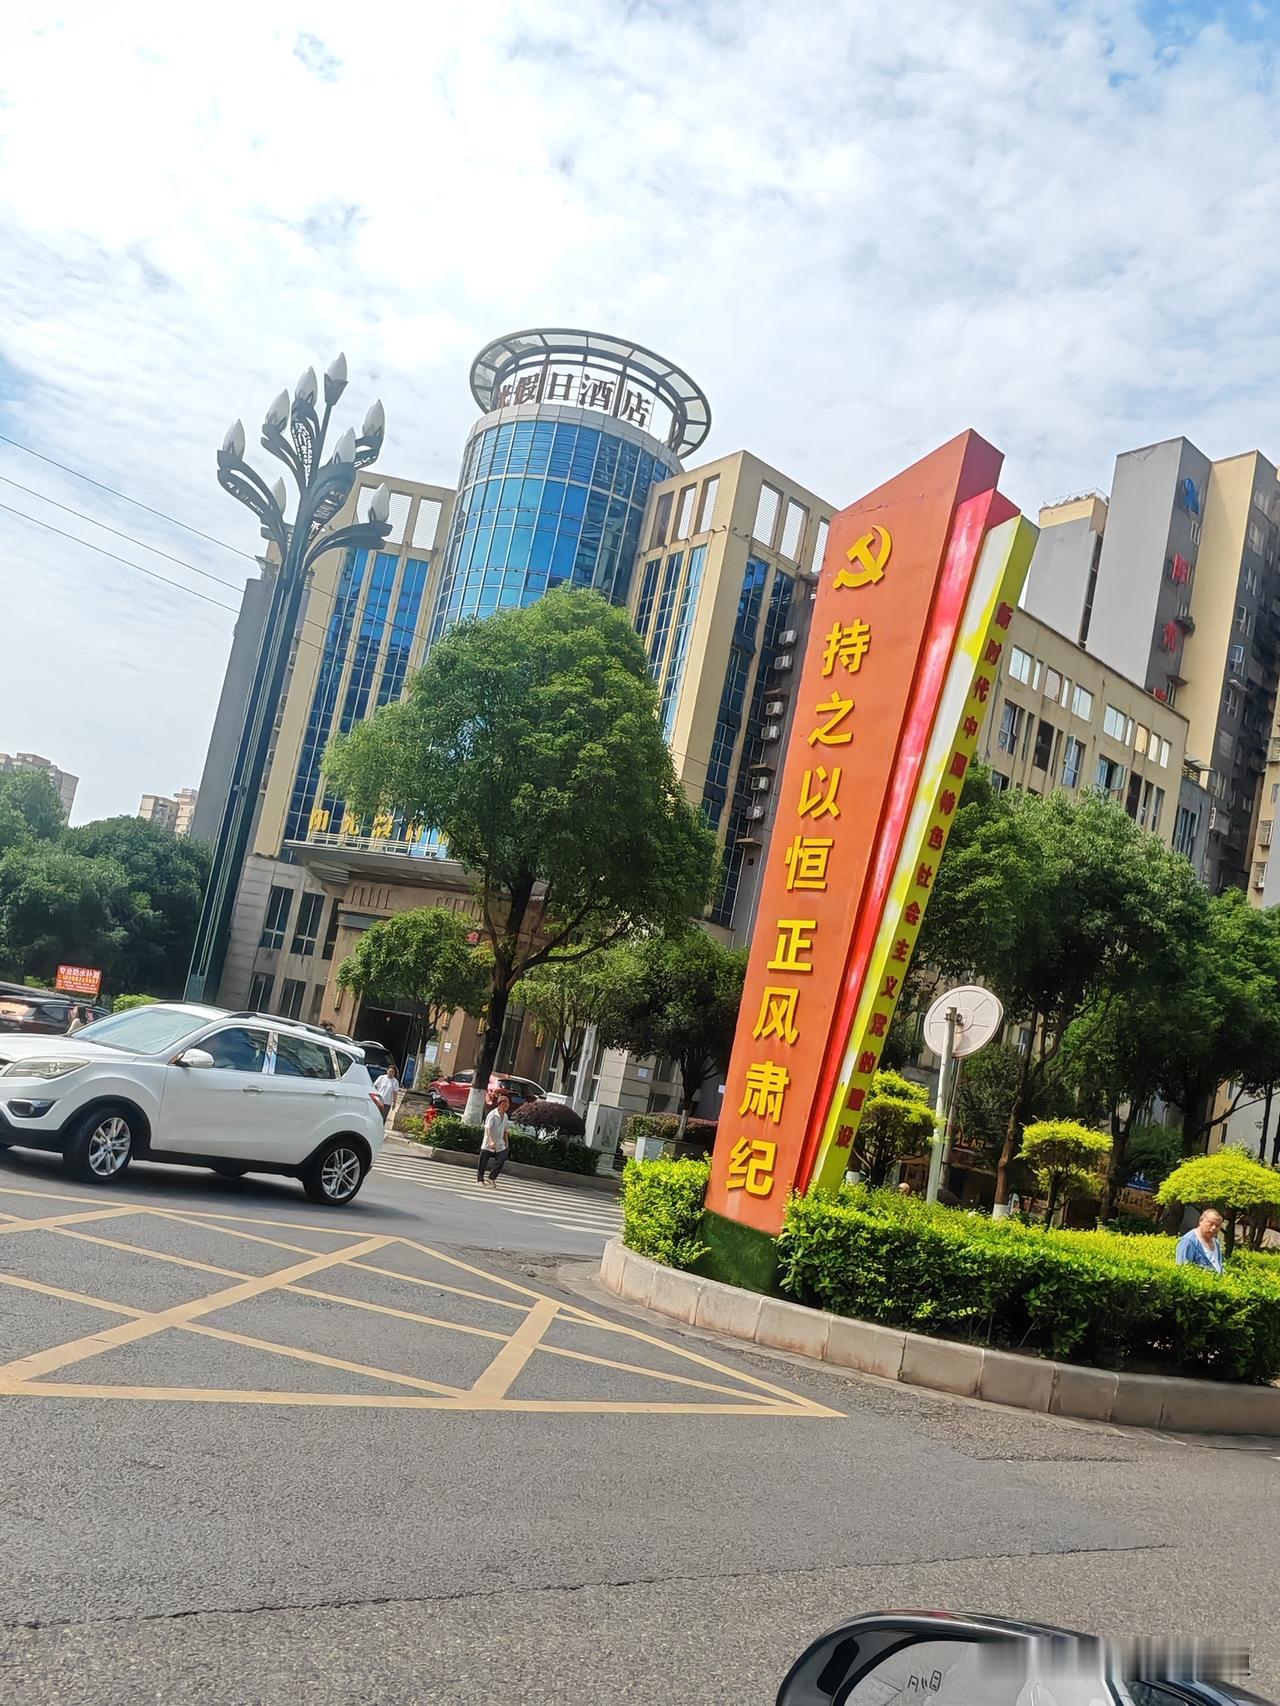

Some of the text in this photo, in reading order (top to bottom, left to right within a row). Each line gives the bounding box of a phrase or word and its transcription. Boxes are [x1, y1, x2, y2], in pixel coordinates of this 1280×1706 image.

[726, 618, 871, 1197] 持之以恒正风肃纪
